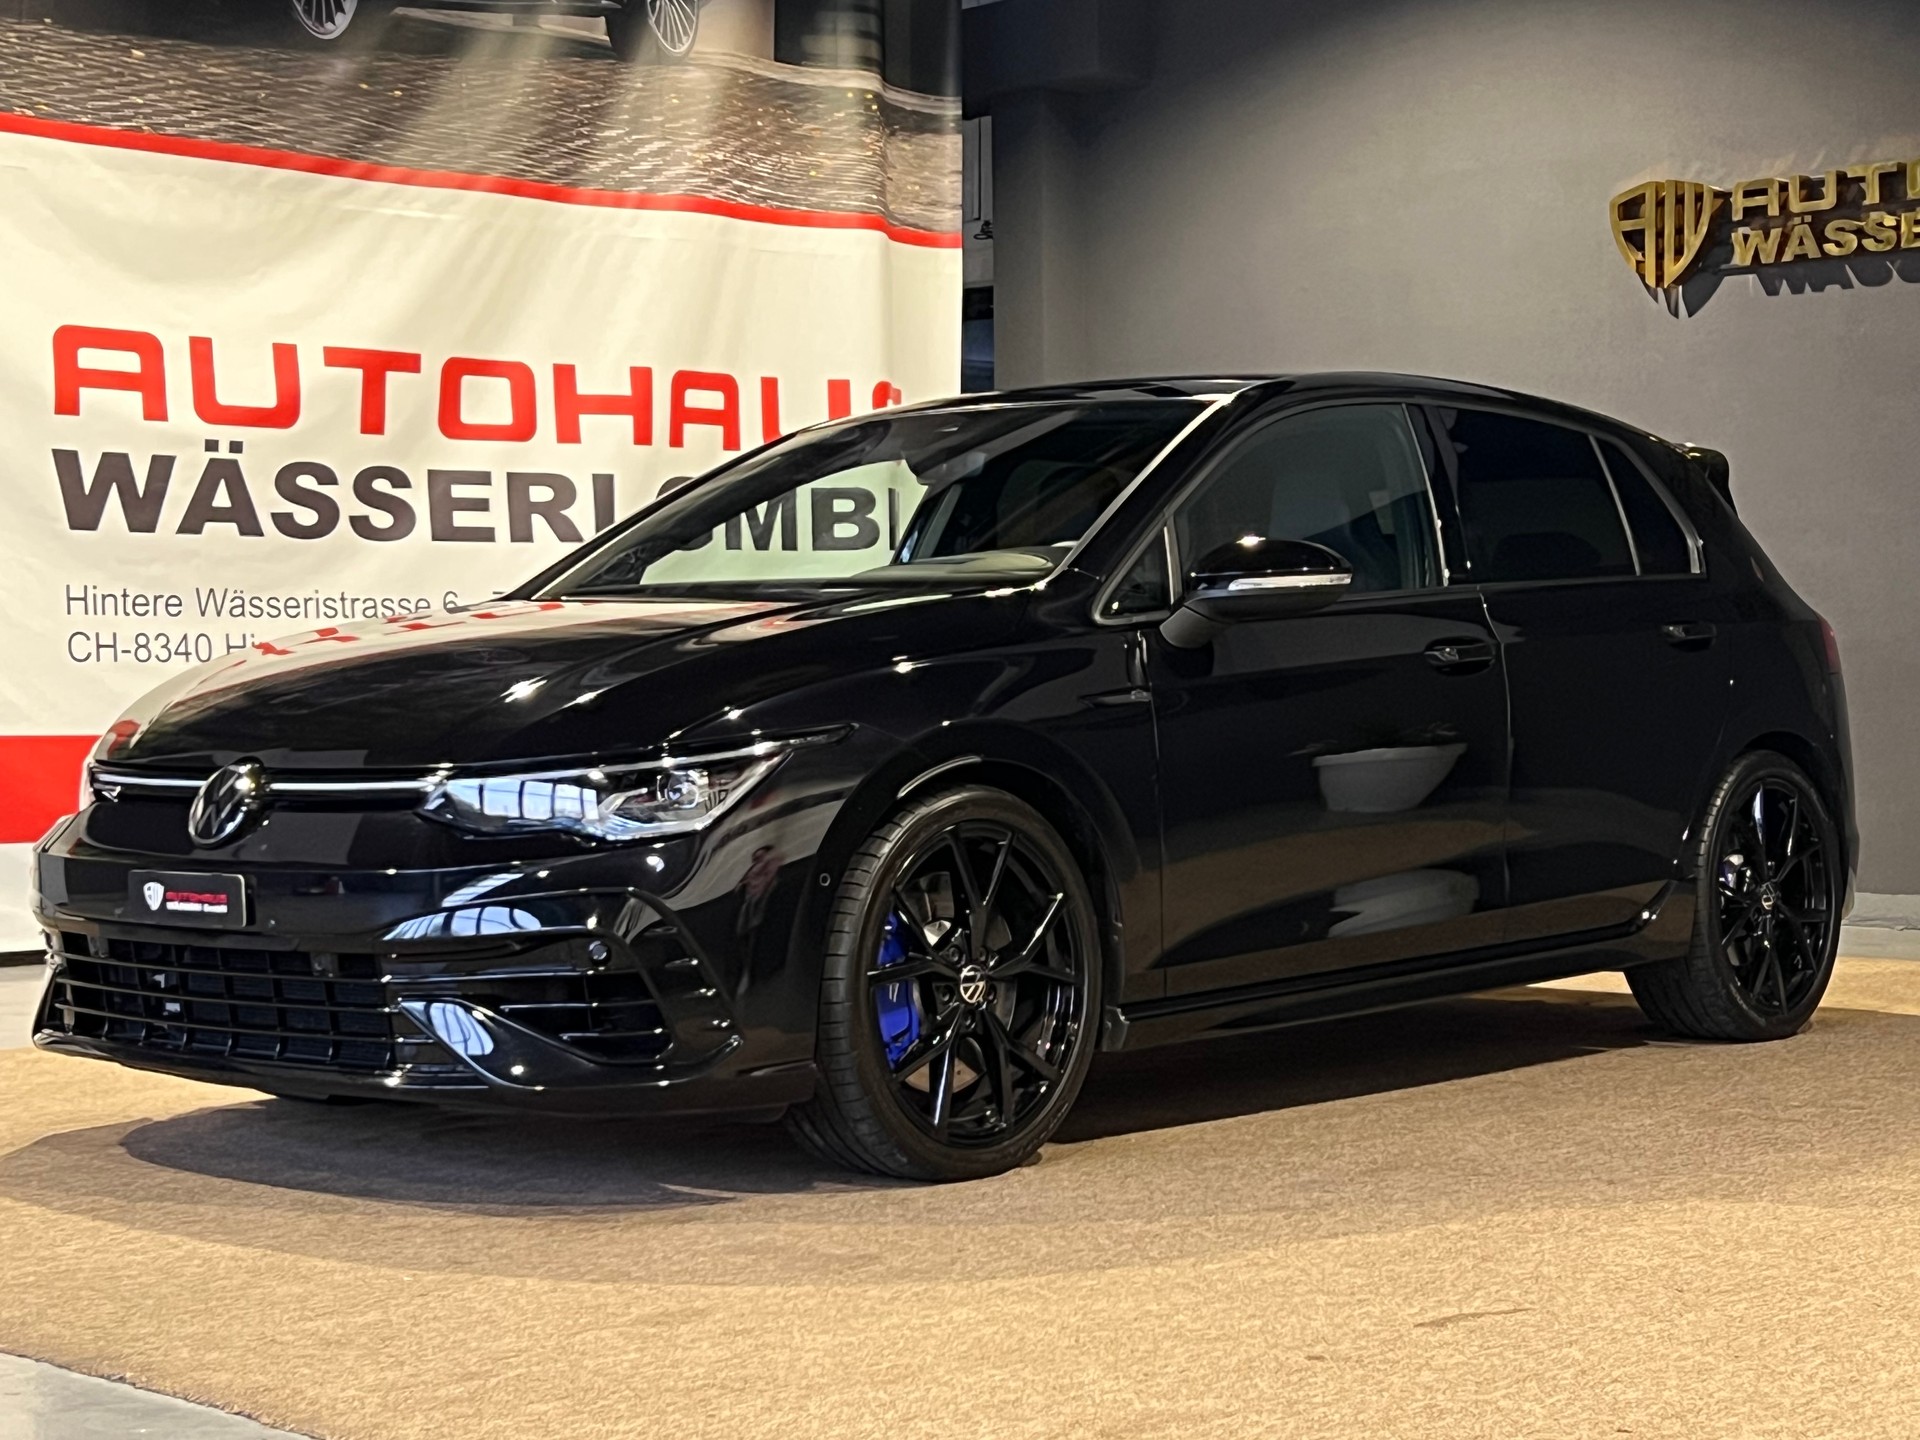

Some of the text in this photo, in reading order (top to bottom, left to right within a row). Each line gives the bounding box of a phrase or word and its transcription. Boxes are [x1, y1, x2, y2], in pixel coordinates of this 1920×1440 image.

[51, 438, 615, 544] WÄSSERI
[65, 584, 183, 618] Hintere
[195, 587, 431, 619] Wässeristrasse
[67, 631, 213, 663] CH-8340
